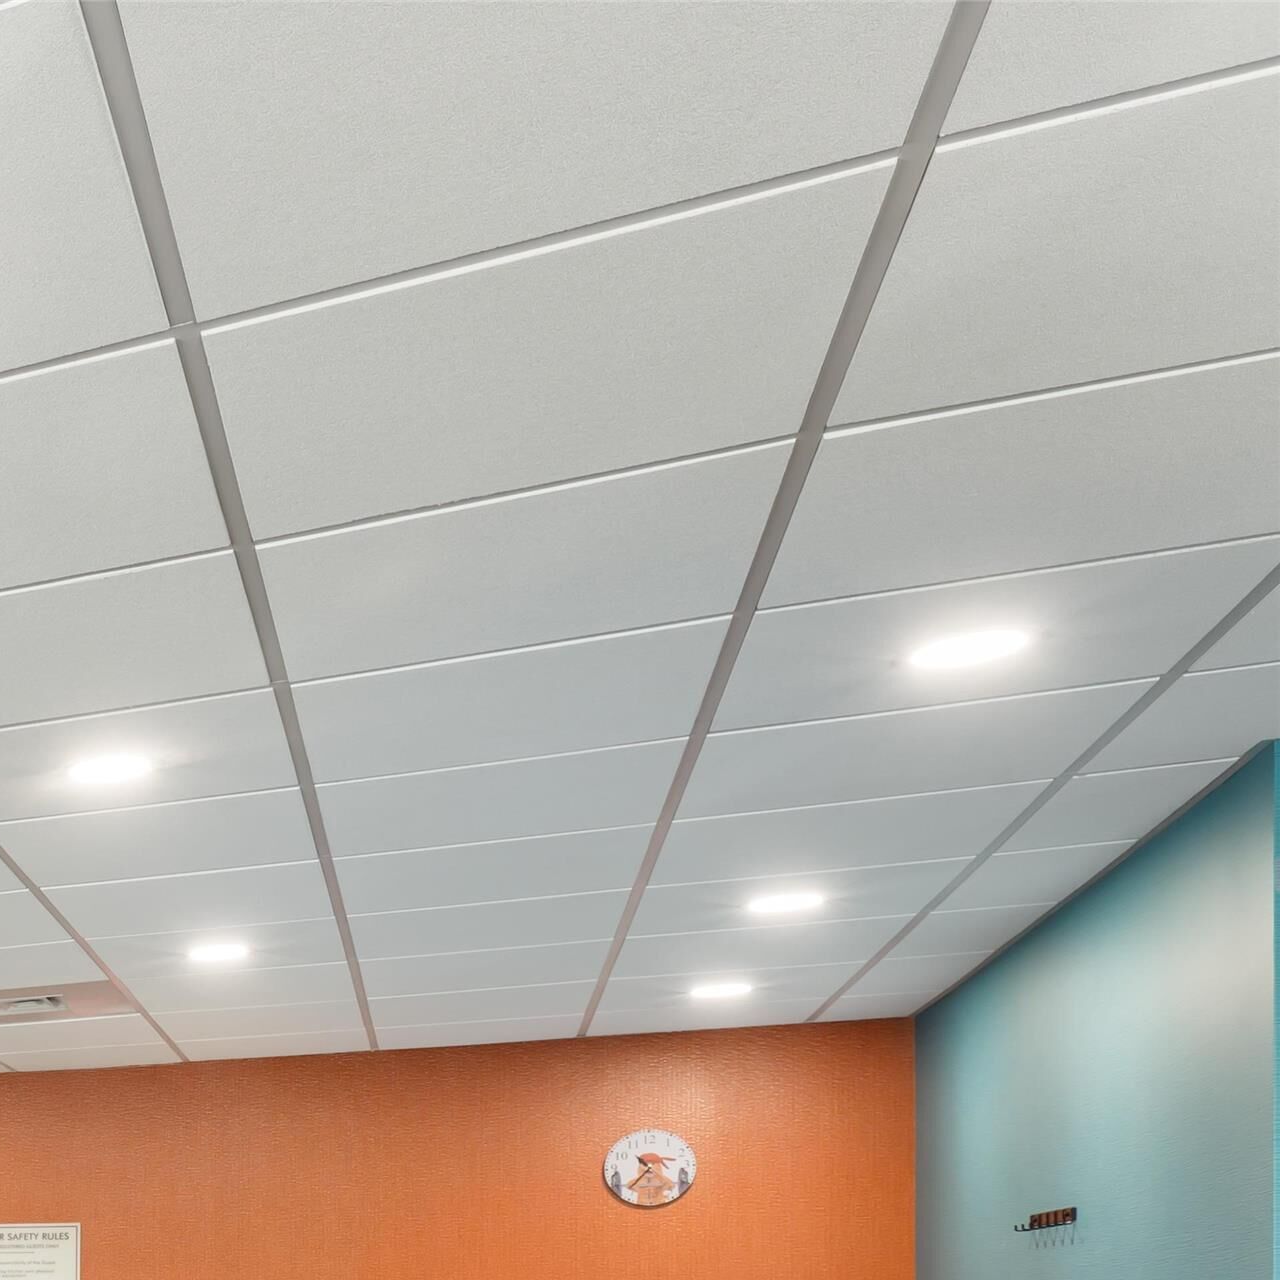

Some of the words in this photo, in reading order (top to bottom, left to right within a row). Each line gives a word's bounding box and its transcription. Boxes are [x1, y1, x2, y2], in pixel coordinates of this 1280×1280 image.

[644, 1135, 656, 1144] 12
[615, 1152, 628, 1161] 10
[7, 1232, 39, 1241] SAFETY
[41, 1232, 70, 1241] RULES
